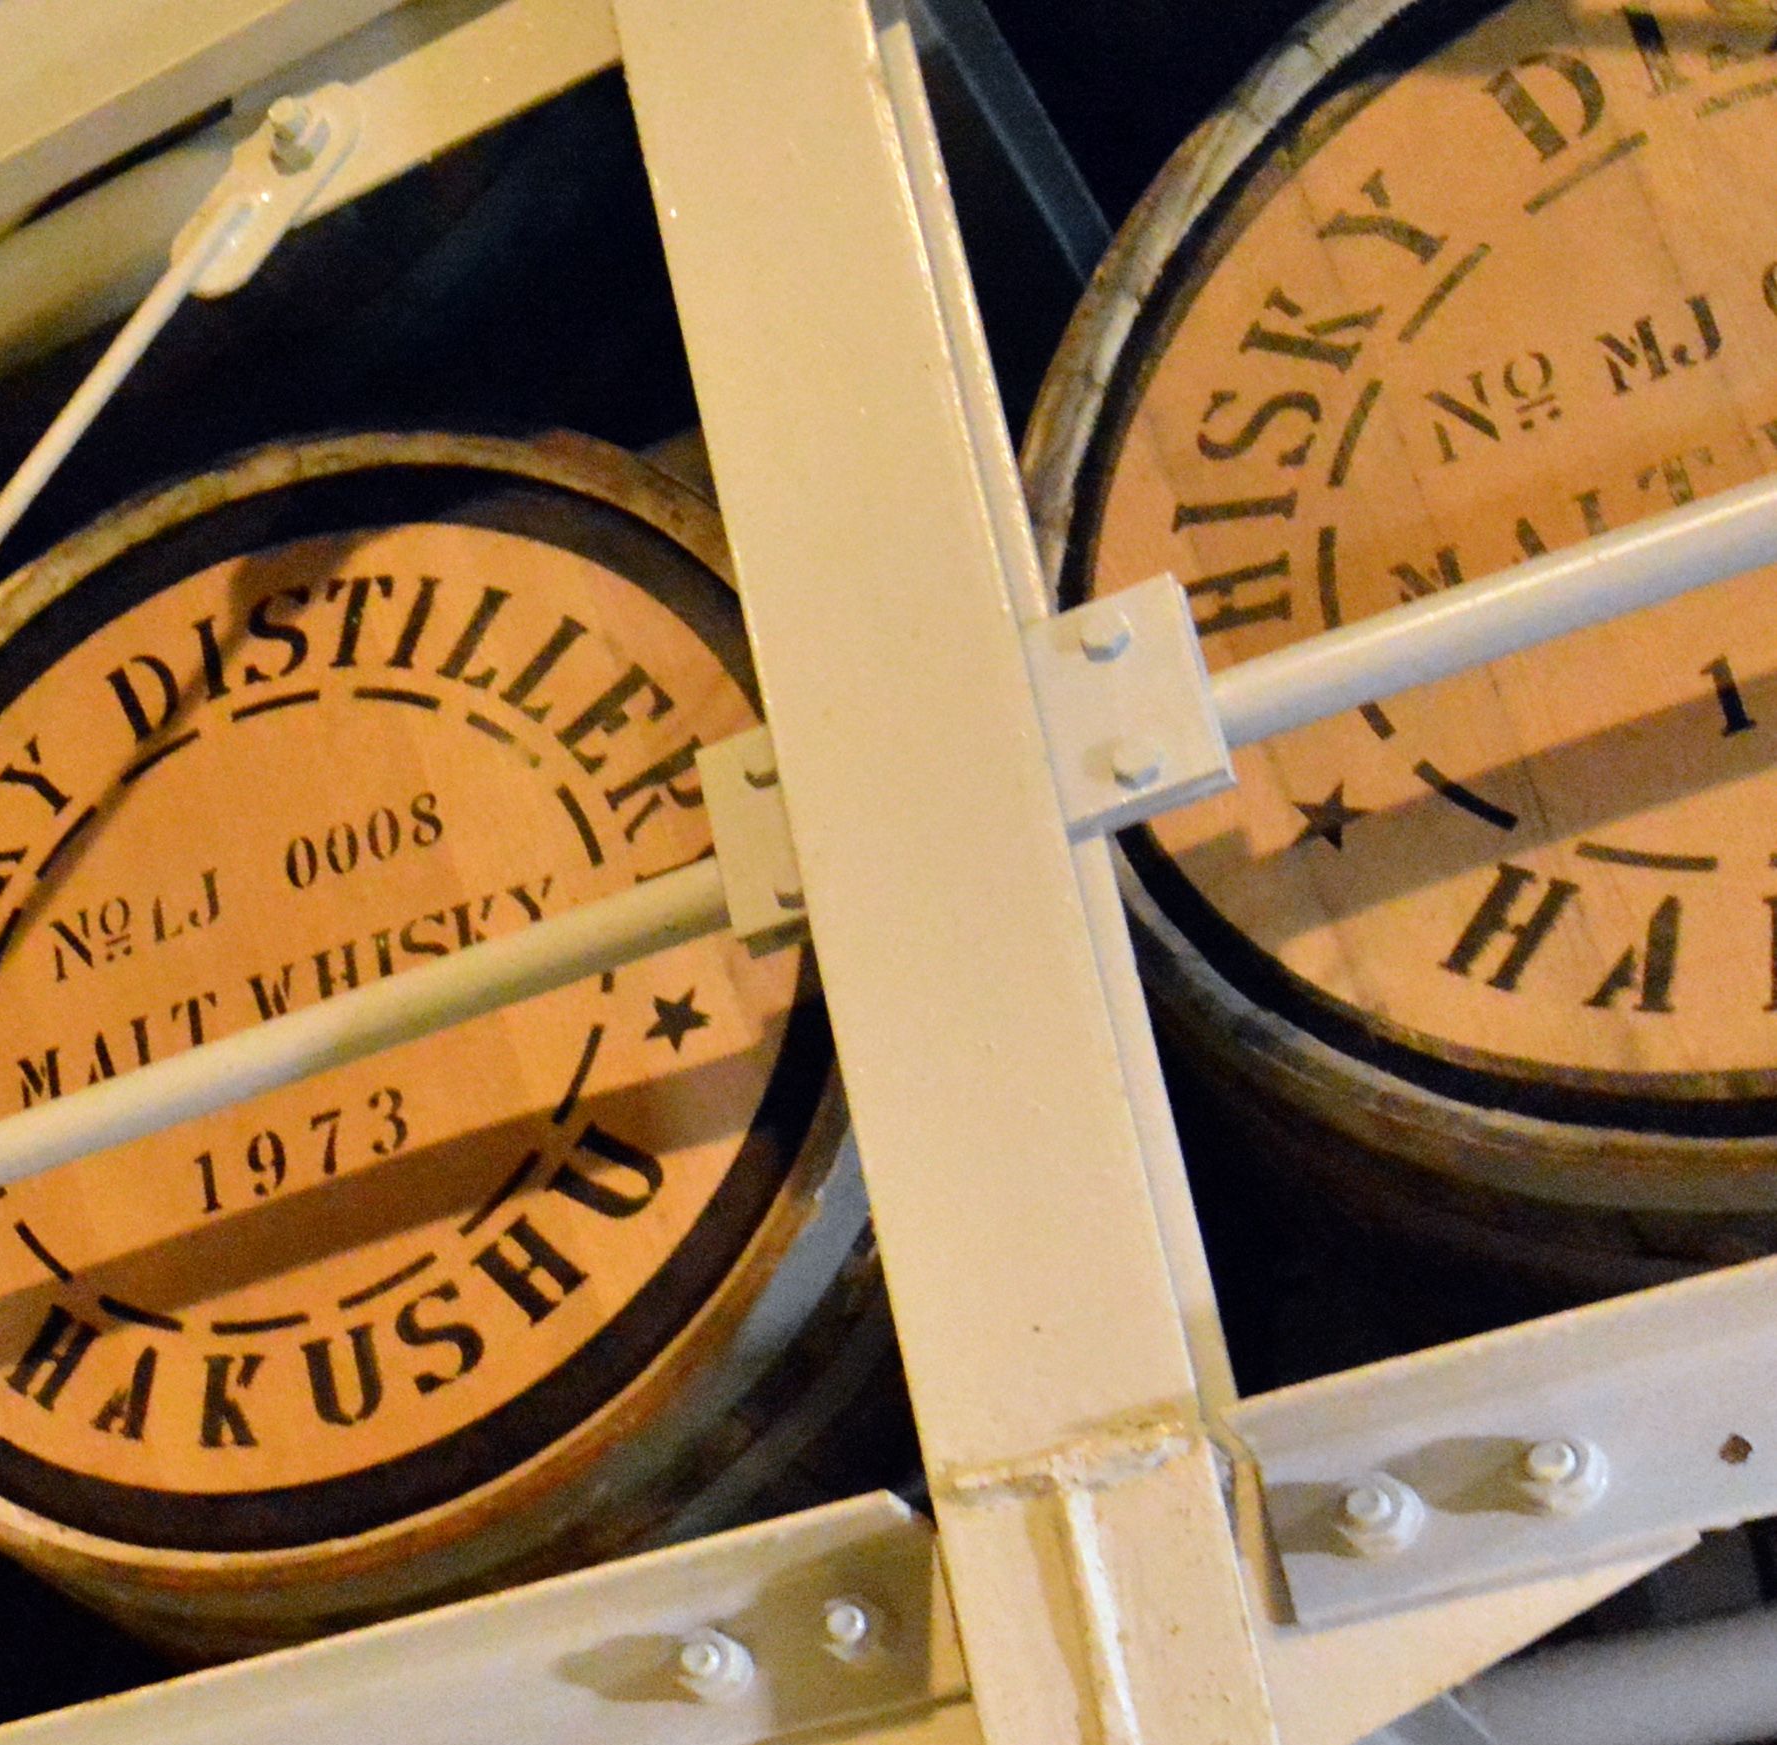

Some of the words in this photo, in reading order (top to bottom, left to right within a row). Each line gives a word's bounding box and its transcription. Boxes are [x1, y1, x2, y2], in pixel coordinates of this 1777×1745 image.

[1173, 168, 1447, 635] HISKY
[1595, 293, 1724, 396] MJ
[150, 867, 223, 944] LJ
[284, 791, 447, 890] 0008
[16, 990, 218, 1110] MALT
[245, 875, 555, 1022] WHISKY
[192, 1085, 410, 1214] 1973
[6, 1120, 663, 1453] HAKUSHU
